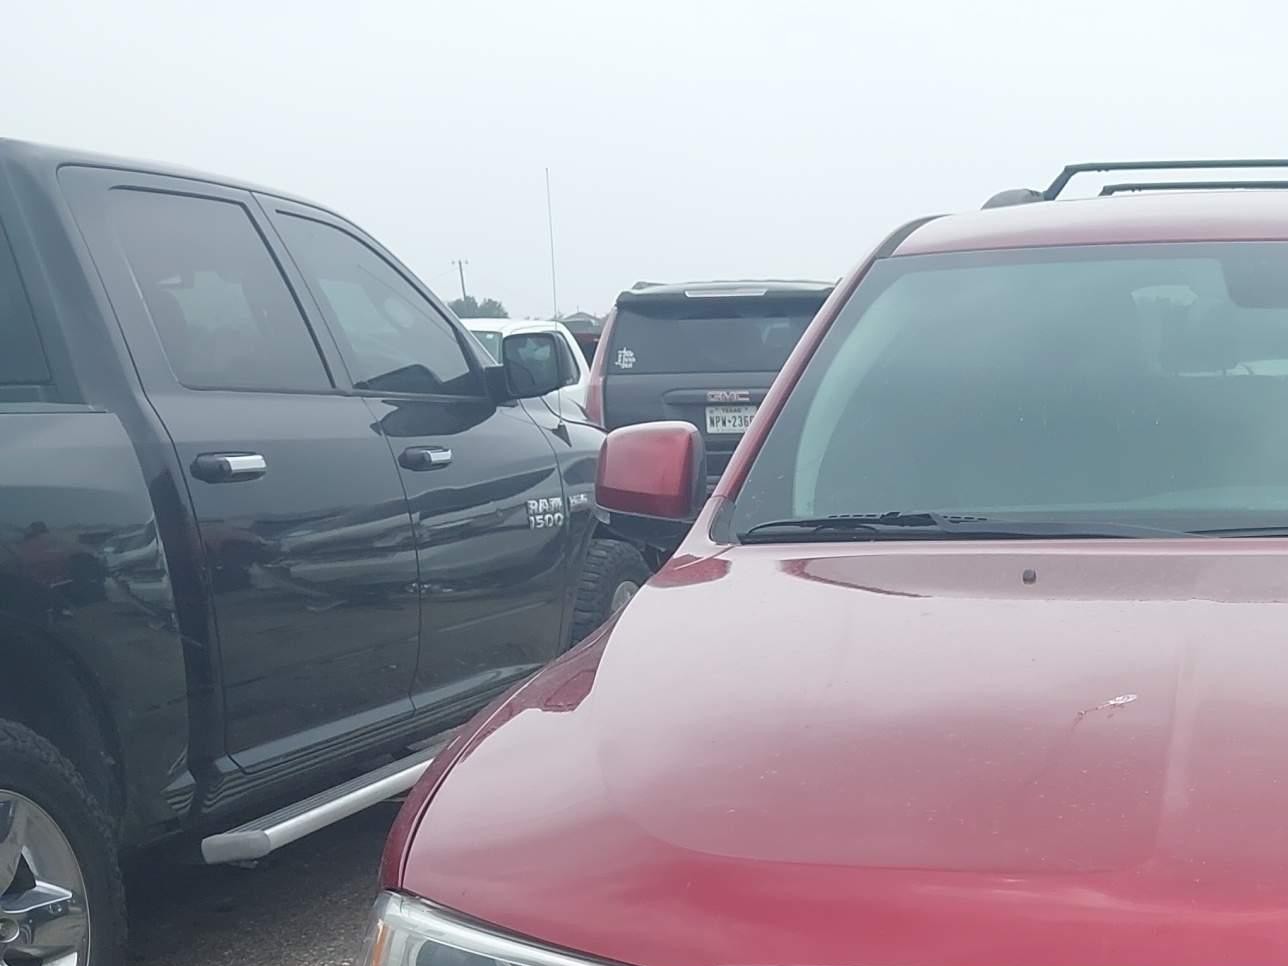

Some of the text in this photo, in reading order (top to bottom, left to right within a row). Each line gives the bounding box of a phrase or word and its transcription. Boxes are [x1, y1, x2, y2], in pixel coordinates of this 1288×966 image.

[706, 390, 750, 402] GMC
[527, 497, 563, 515] RAM
[528, 512, 564, 530] 1500
